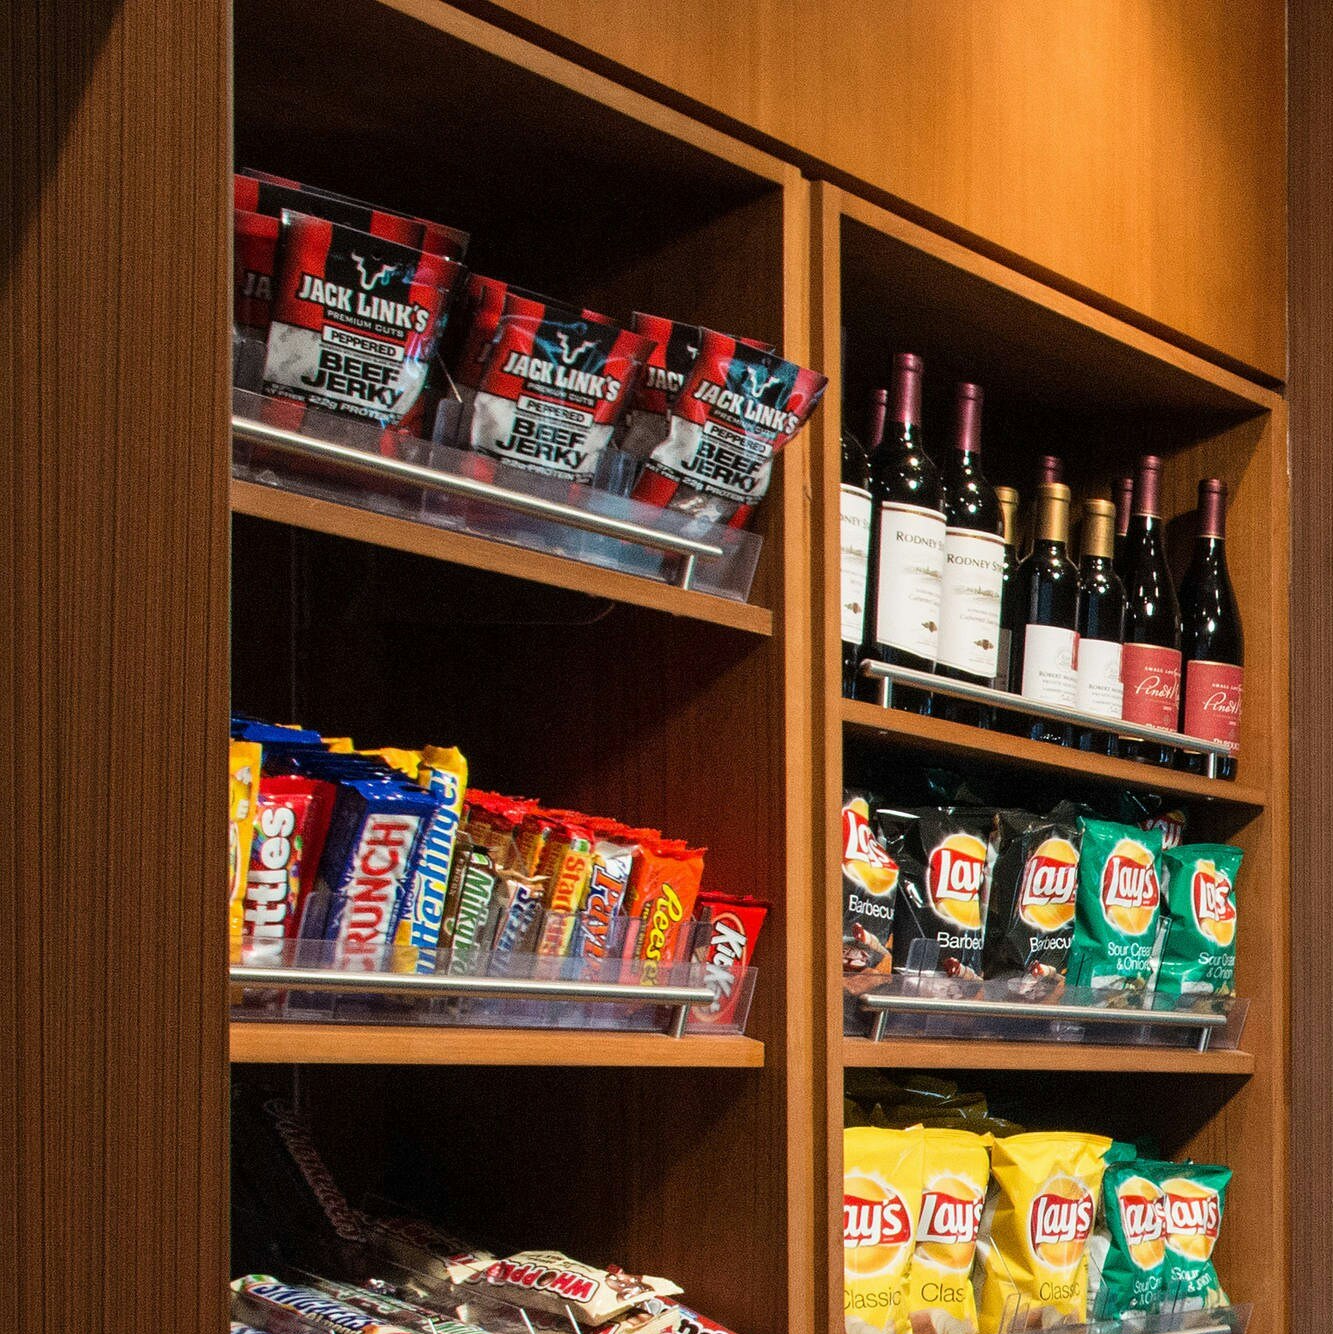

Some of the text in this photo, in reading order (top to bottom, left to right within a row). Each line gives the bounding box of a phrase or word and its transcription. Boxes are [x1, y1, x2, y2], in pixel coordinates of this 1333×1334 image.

[299, 274, 430, 334] JACK LINK'S
[327, 309, 405, 338] PREMIUM CUTS
[331, 330, 397, 357] PEPPERED
[319, 350, 400, 387] BEEF
[503, 352, 622, 402] JACK LINK'S
[301, 370, 404, 409] JERKY
[693, 380, 743, 415] JACK
[527, 401, 586, 423] PEPPERED
[512, 416, 587, 448] BEEF
[495, 435, 589, 469] JERKY
[697, 440, 763, 475] BEEF
[680, 456, 760, 493] JERKY
[896, 530, 937, 549] RODNEY
[946, 553, 990, 569] RODNEY
[1106, 857, 1155, 908] Lay's
[848, 894, 896, 921] Barbecu
[1030, 935, 1074, 953] Barbecu
[1108, 942, 1130, 957] Sour
[844, 1198, 904, 1249] ay's
[1035, 1195, 1093, 1245] Lay's
[1165, 1195, 1220, 1237] Lay's
